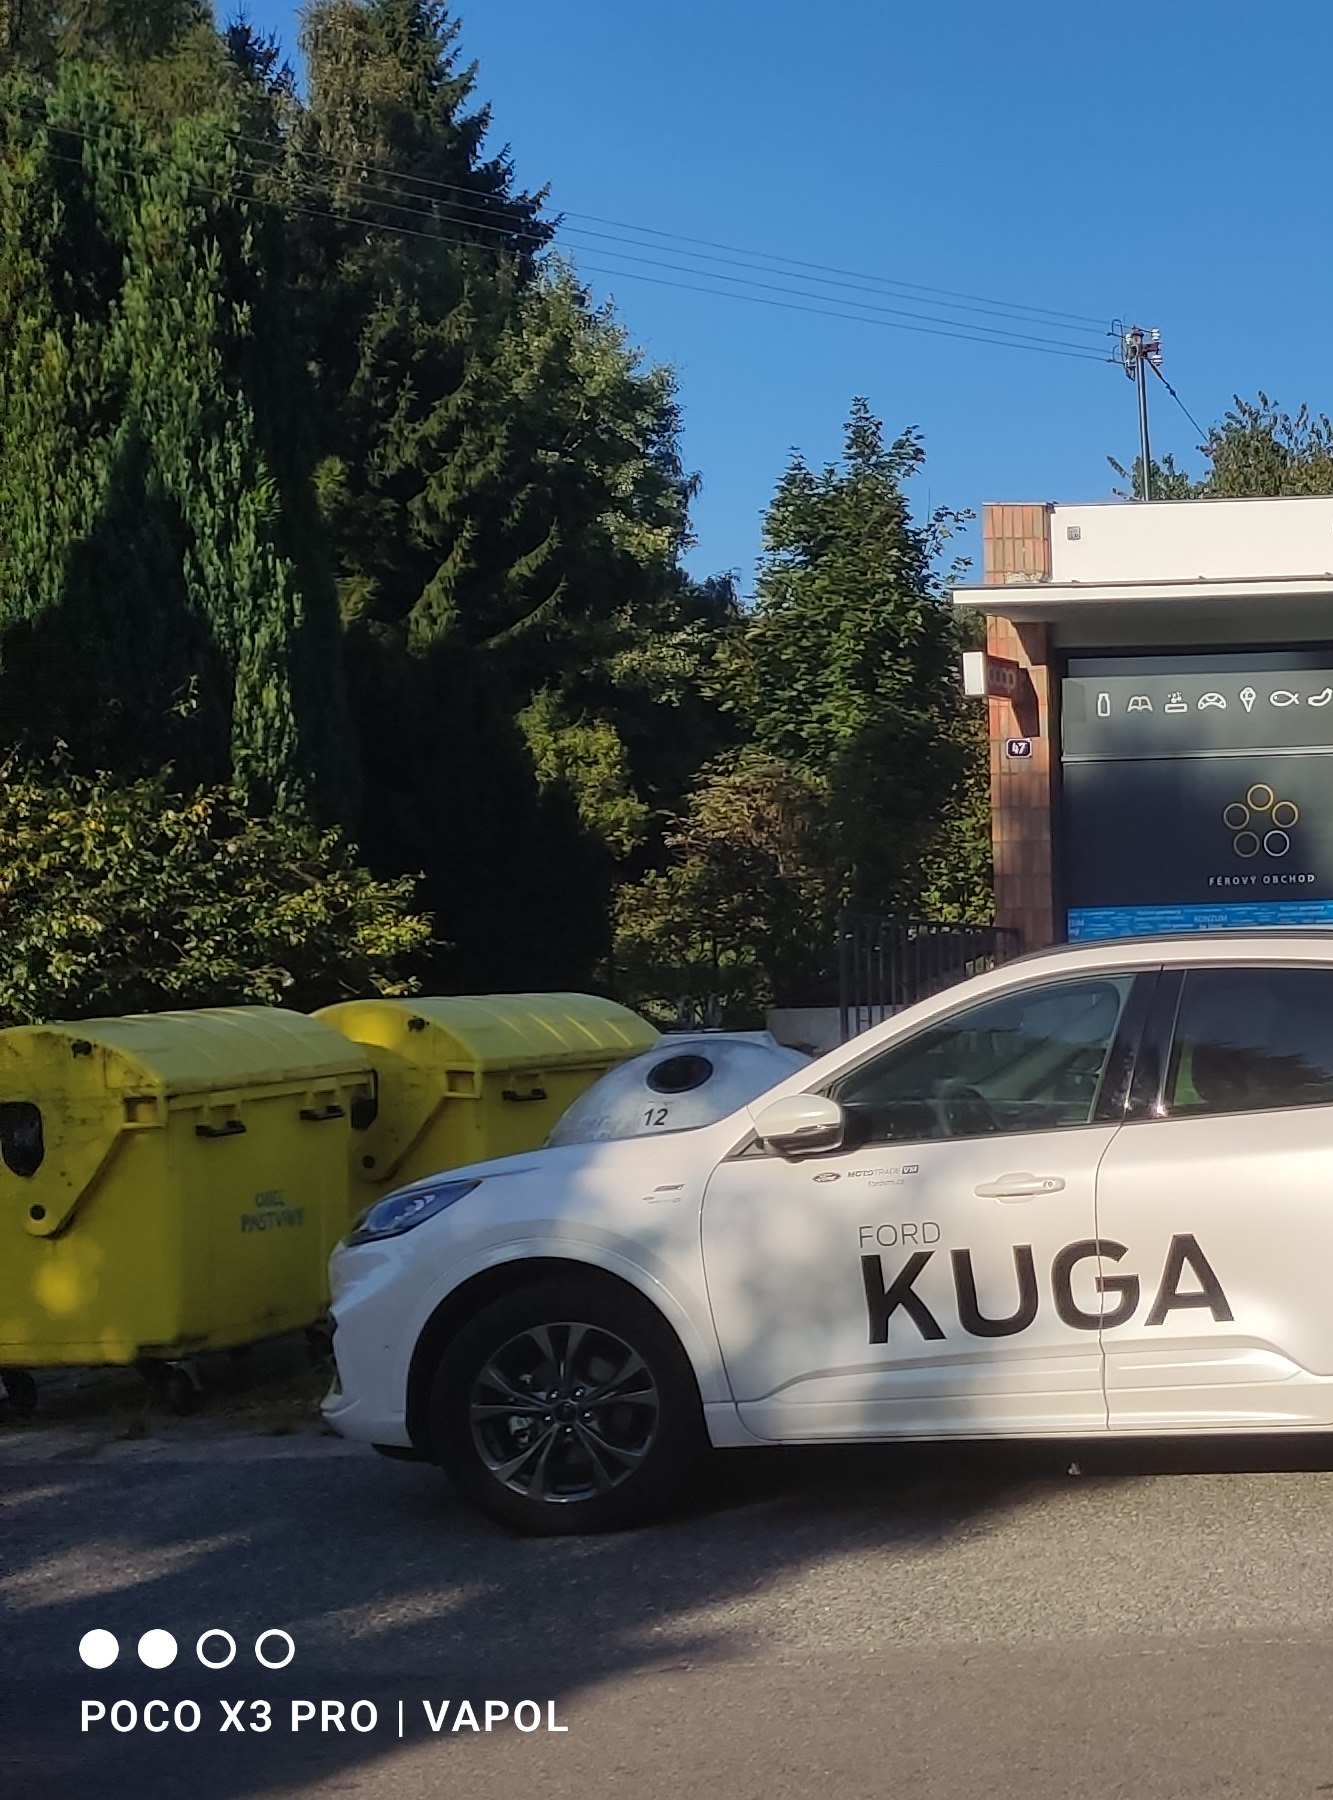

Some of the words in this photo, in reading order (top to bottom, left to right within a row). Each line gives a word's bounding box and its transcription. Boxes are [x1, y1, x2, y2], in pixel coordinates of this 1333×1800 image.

[1011, 741, 1028, 755] 47
[1262, 874, 1316, 885] OBCHOD
[643, 1107, 669, 1126] 12
[858, 1221, 941, 1249] FORD
[860, 1233, 1235, 1345] KUGA
